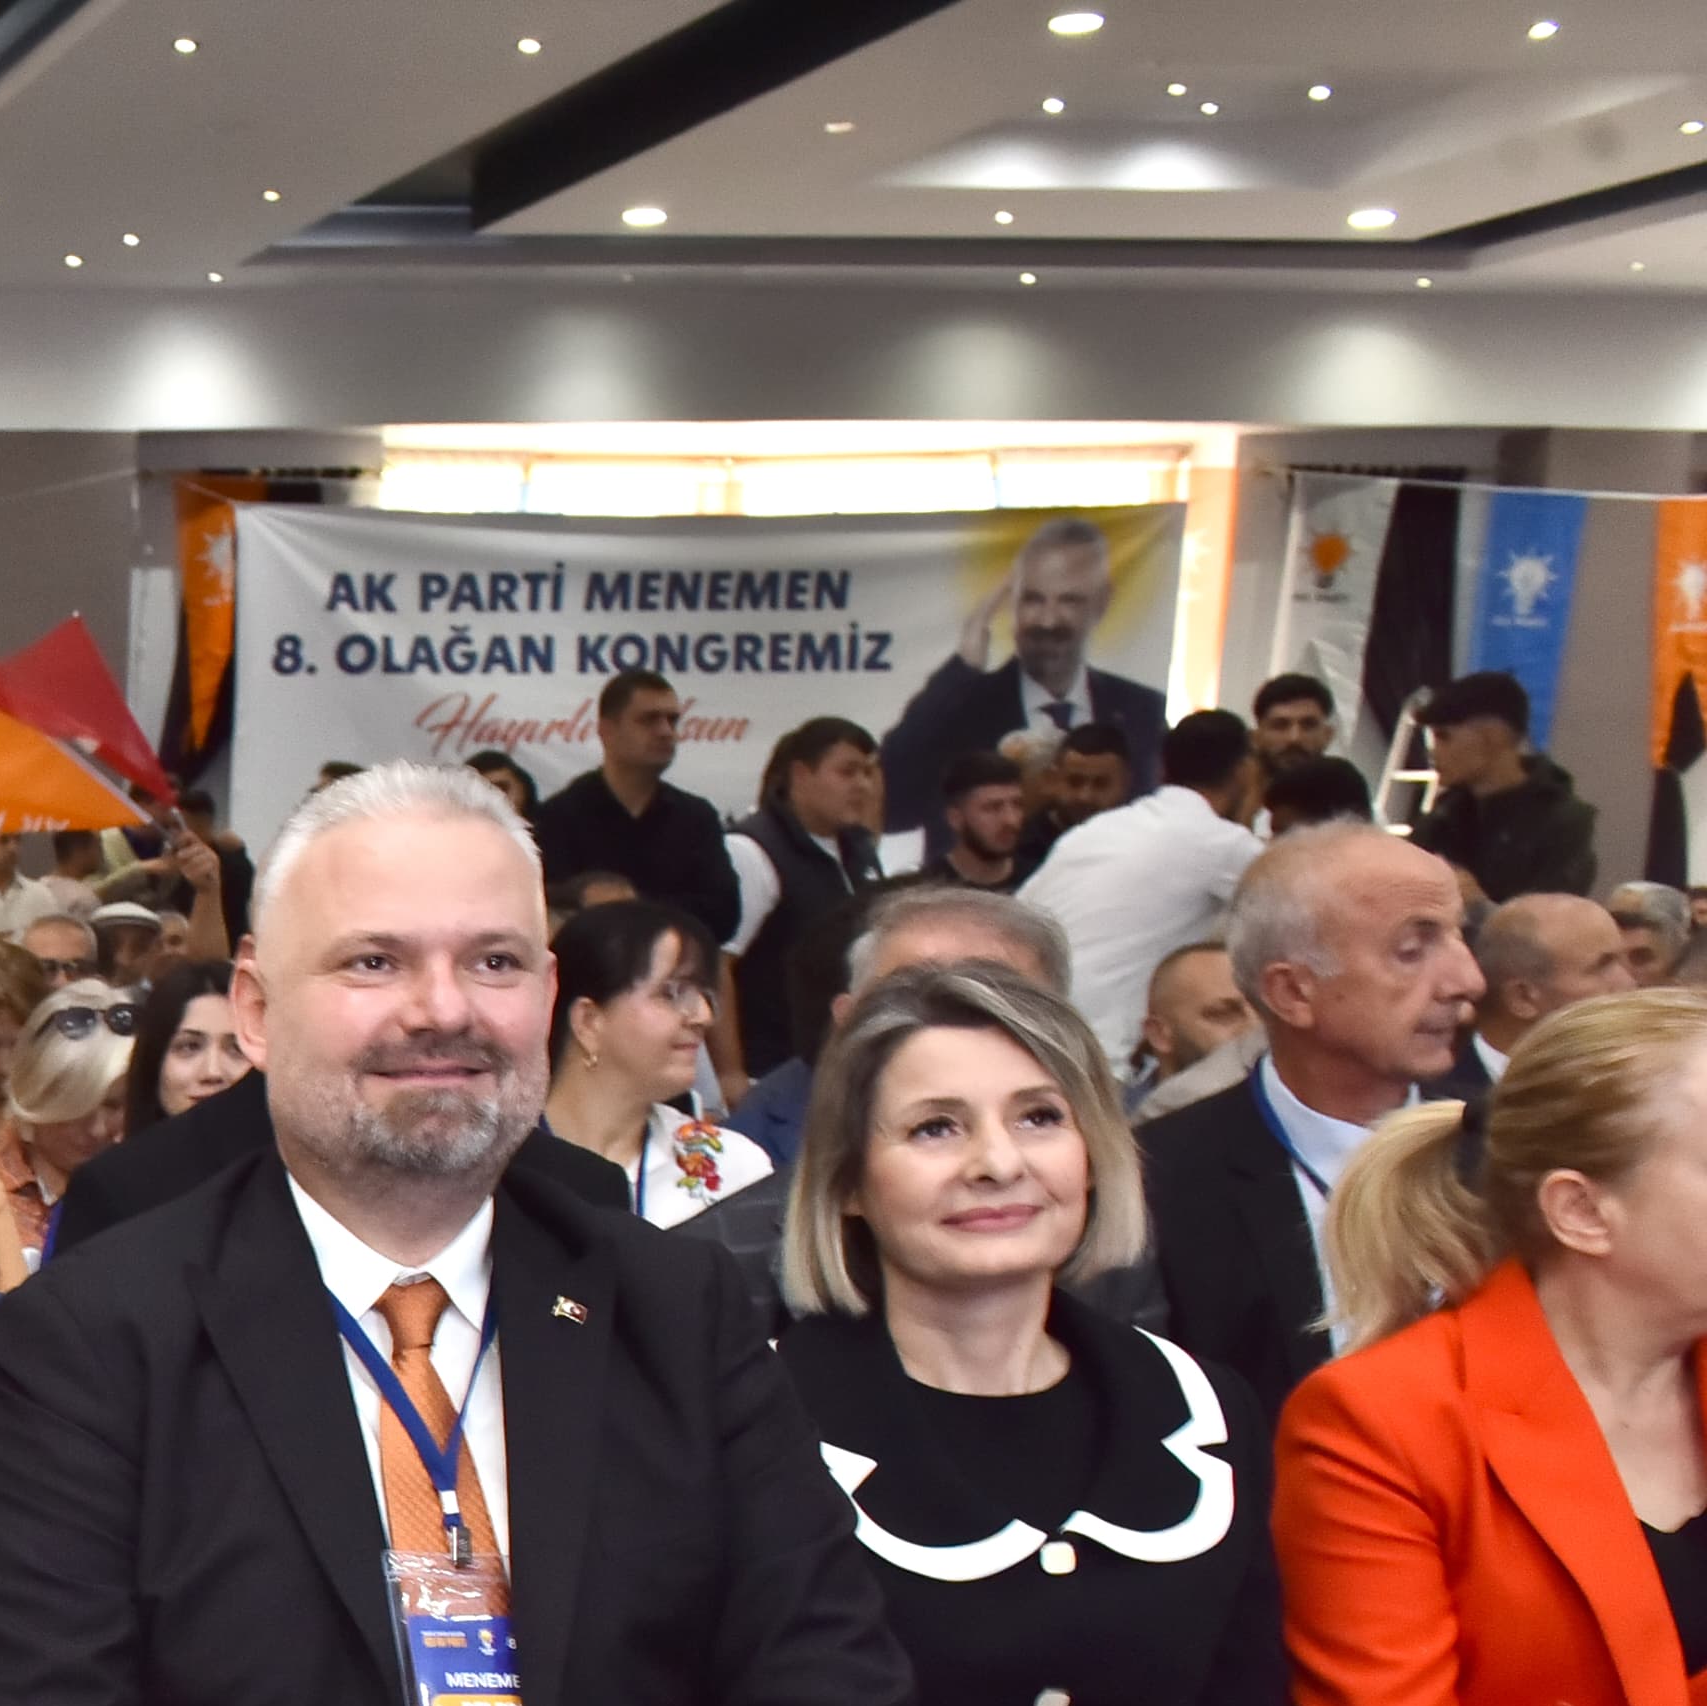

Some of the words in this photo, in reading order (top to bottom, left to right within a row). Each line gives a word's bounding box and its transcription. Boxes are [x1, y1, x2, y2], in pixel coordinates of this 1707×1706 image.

[325, 572, 397, 612] AK
[419, 562, 565, 612] PARTİ
[584, 570, 851, 611] MENEMEN
[272, 633, 317, 675] 8.
[335, 626, 556, 675] OLAĞAN
[576, 621, 894, 673] KONGREMİZ
[445, 1671, 521, 1688] MENEME
